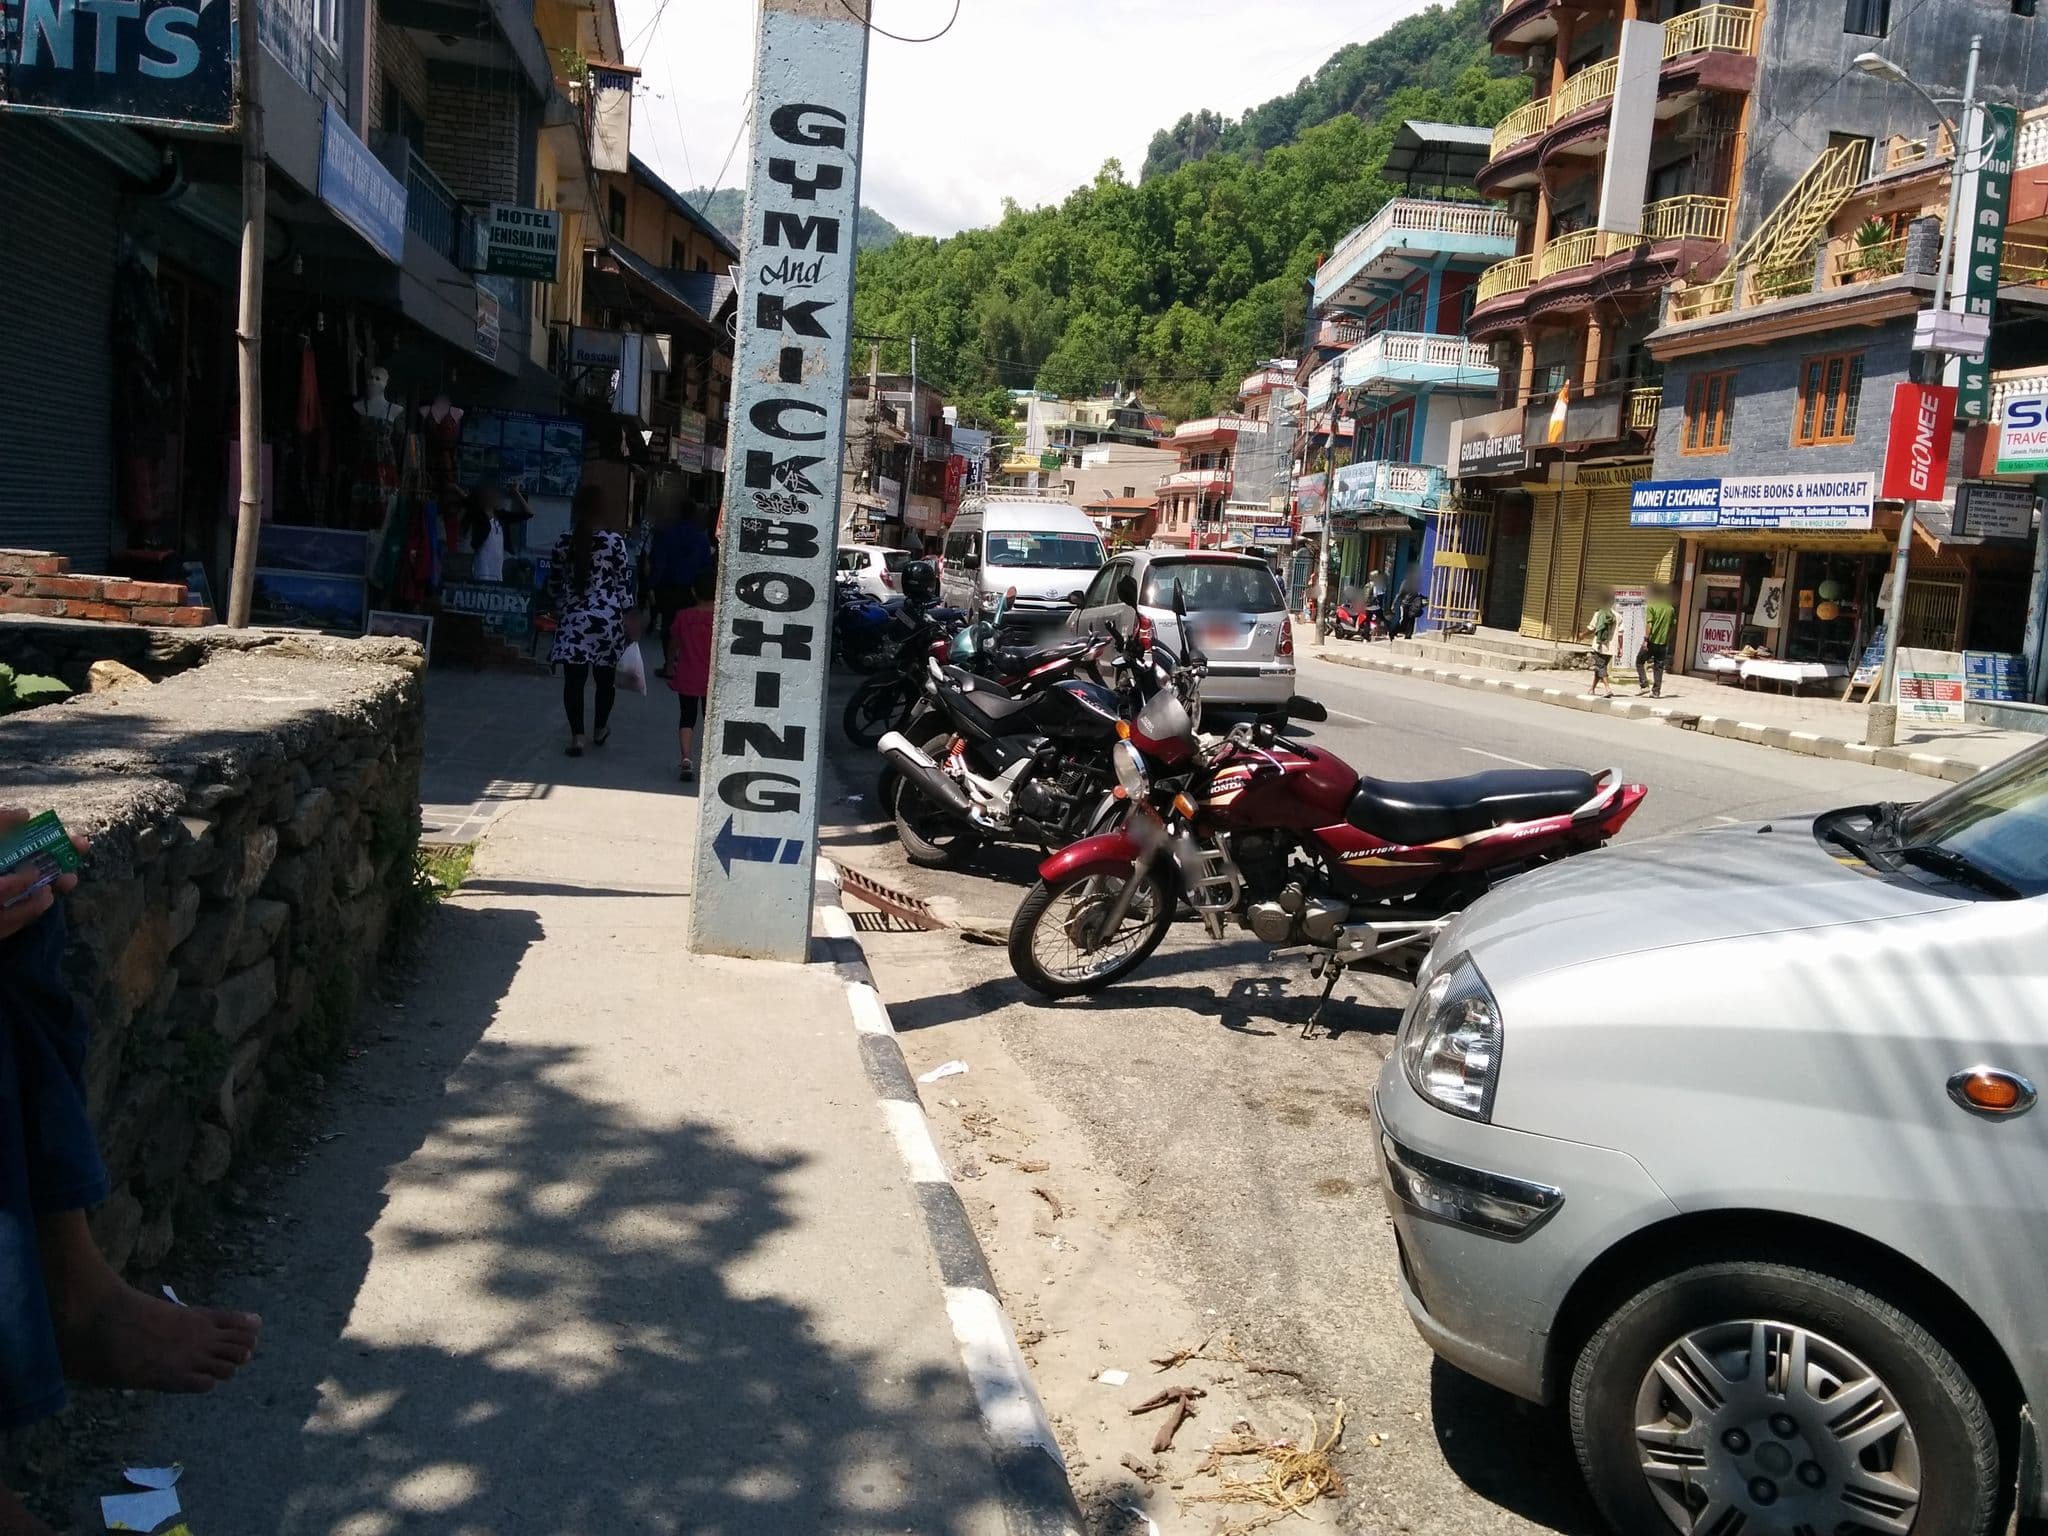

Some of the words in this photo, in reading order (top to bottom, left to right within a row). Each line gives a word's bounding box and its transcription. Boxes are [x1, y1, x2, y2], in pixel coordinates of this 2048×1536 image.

[600, 72, 628, 91] HOTEL
[763, 104, 847, 254] GYM
[497, 208, 552, 228] HOTEL
[537, 233, 556, 251] INN
[760, 255, 825, 293] And
[2007, 400, 2048, 430] S
[2006, 431, 2048, 446] TRAVE
[1461, 439, 1485, 462] GOLDEN
[1485, 437, 1503, 458] GATE
[1632, 490, 1666, 507] MONEY
[1666, 488, 1720, 507] EXCHANGE
[1723, 486, 1762, 499] SUN-RISE
[1763, 485, 1794, 498] BOOKS
[1796, 484, 1803, 498] &
[1806, 482, 1868, 497] HANDICRAFT
[441, 588, 532, 615] LAUNDRY
[1704, 628, 1733, 643] MONEY
[1337, 844, 1397, 861] AMBITION
